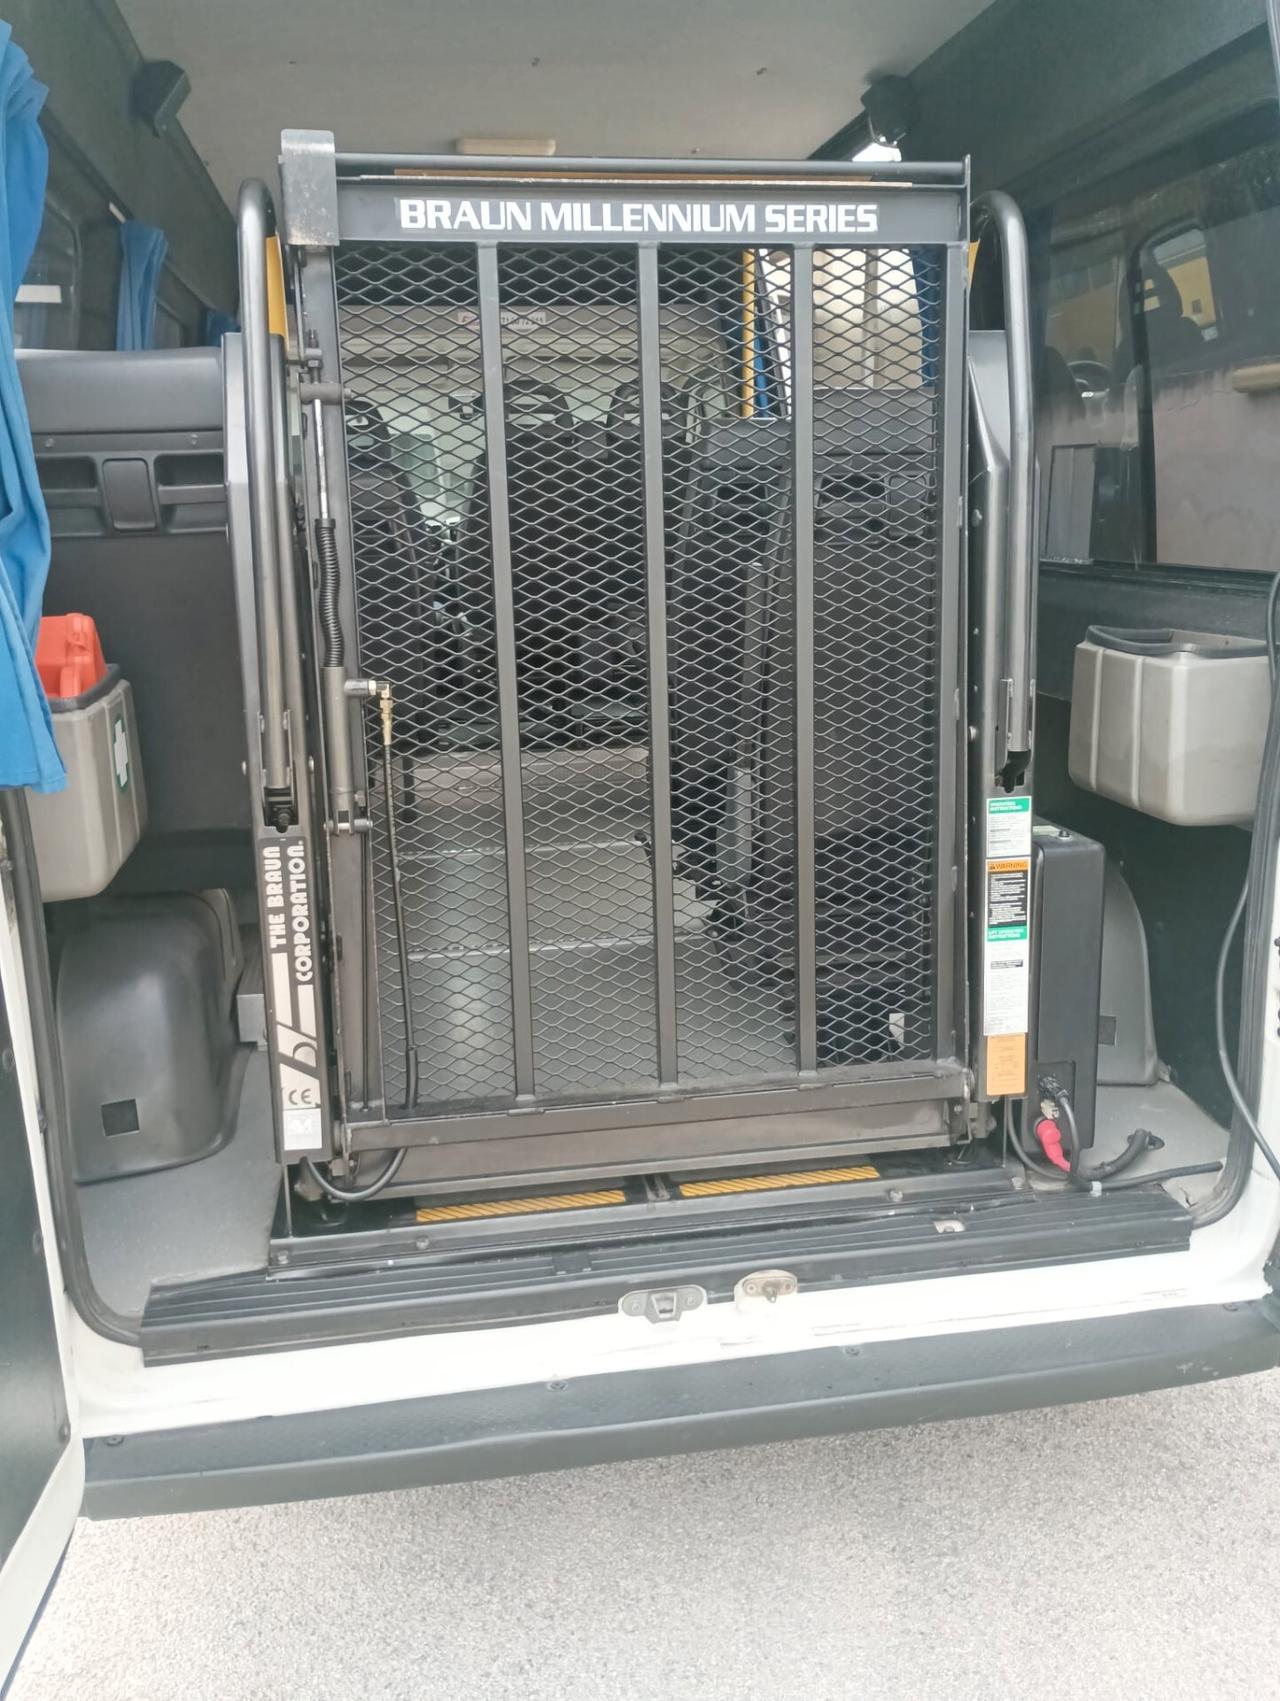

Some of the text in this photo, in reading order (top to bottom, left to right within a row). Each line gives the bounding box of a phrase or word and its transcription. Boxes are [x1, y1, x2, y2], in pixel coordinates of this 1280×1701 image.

[400, 199, 878, 233] BRAUN MILLENNIUM SERIES
[263, 846, 286, 948] THE BRAUN
[288, 1088, 312, 1106] CE
